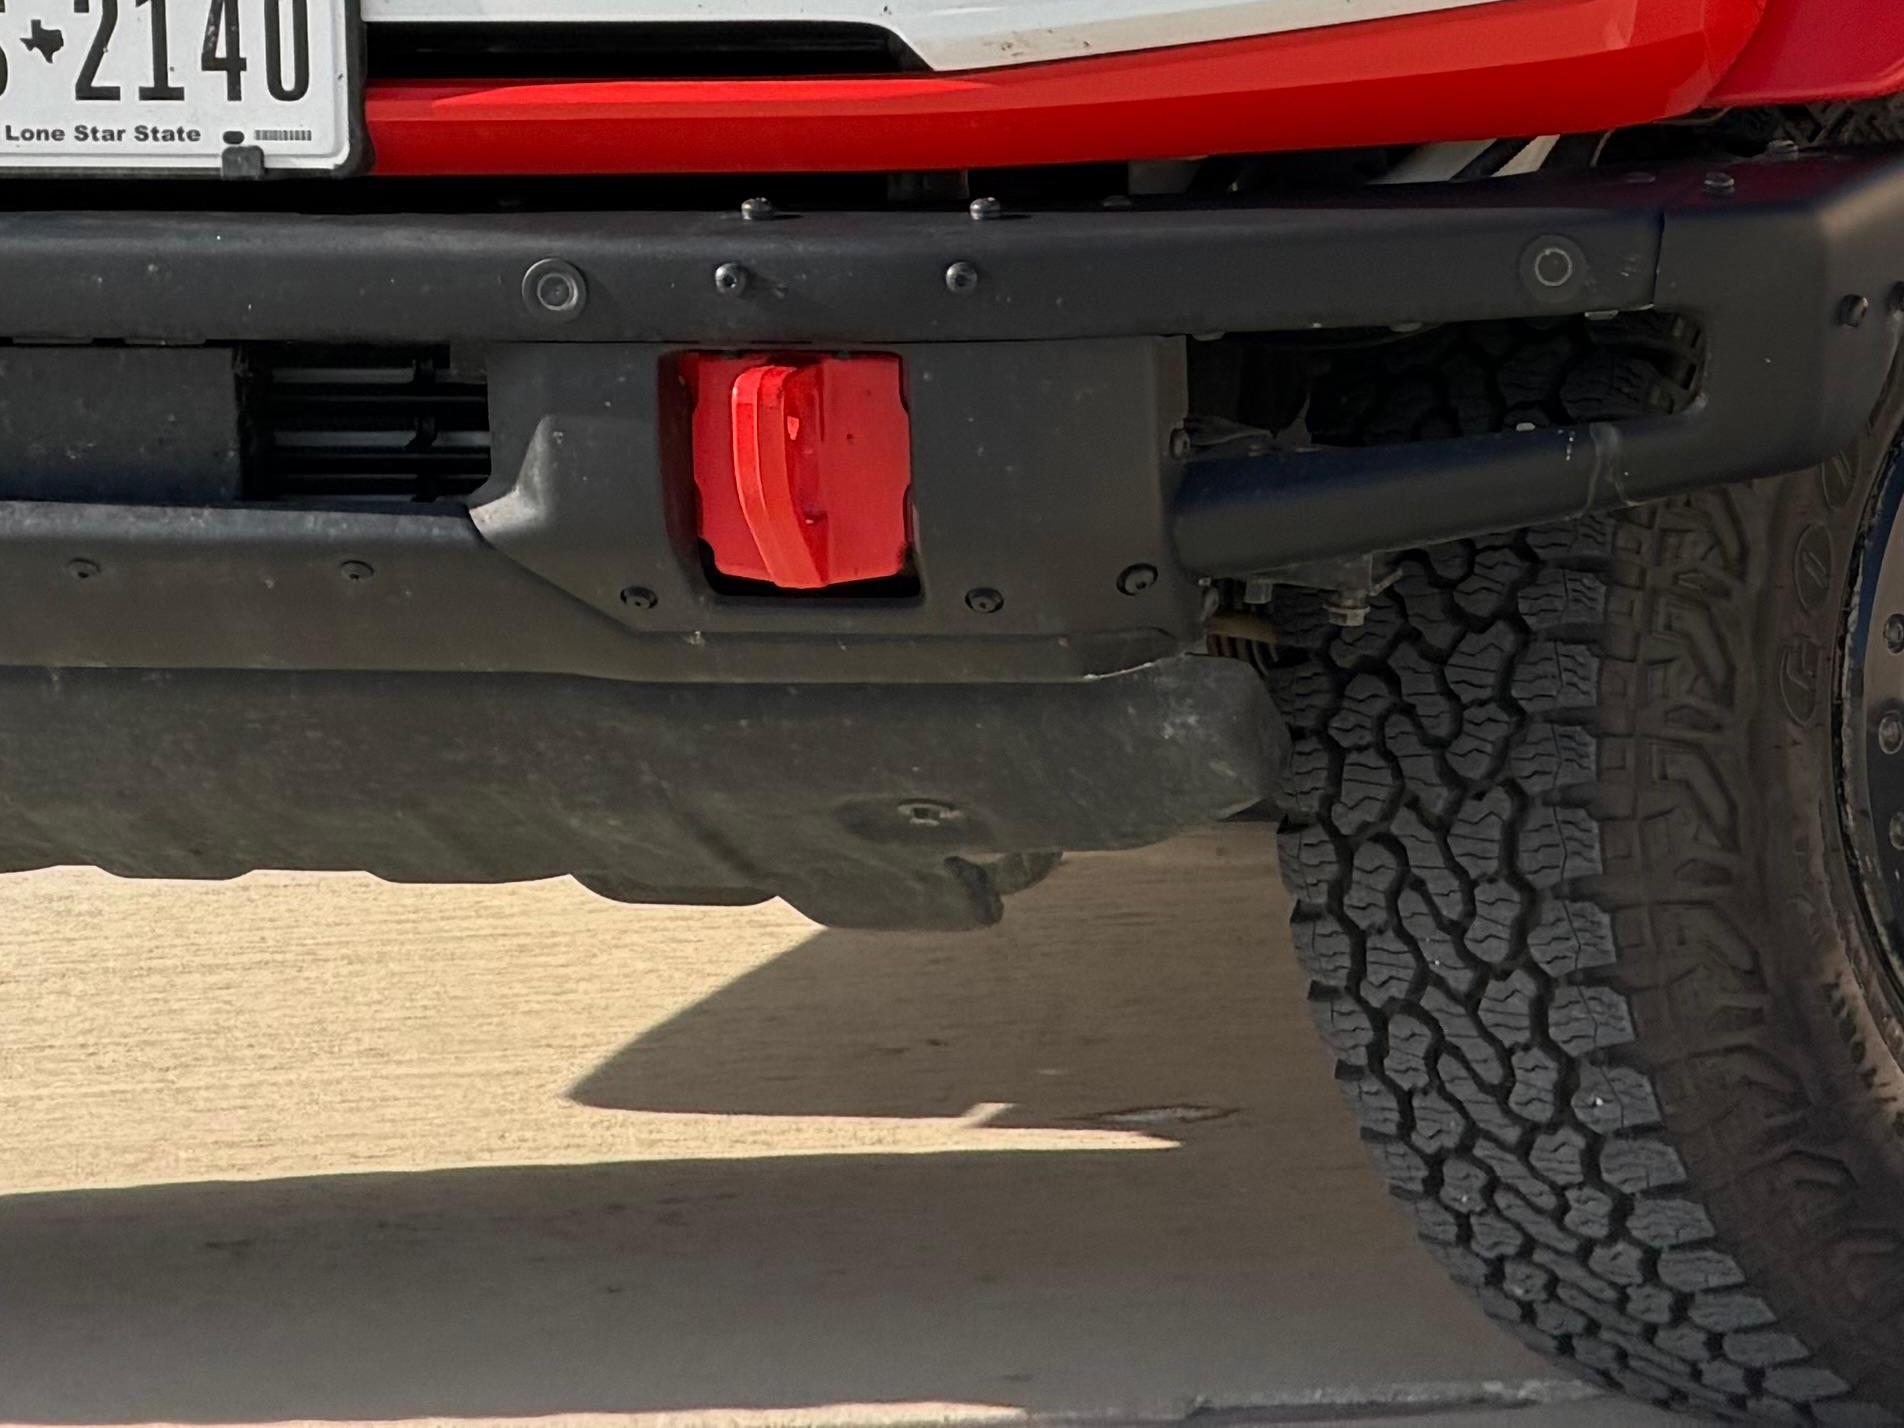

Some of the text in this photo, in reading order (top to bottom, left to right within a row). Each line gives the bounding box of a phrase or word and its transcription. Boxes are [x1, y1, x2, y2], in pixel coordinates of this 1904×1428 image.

[4, 125, 69, 142] Lone
[74, 125, 129, 142] Star
[134, 125, 202, 143] State
